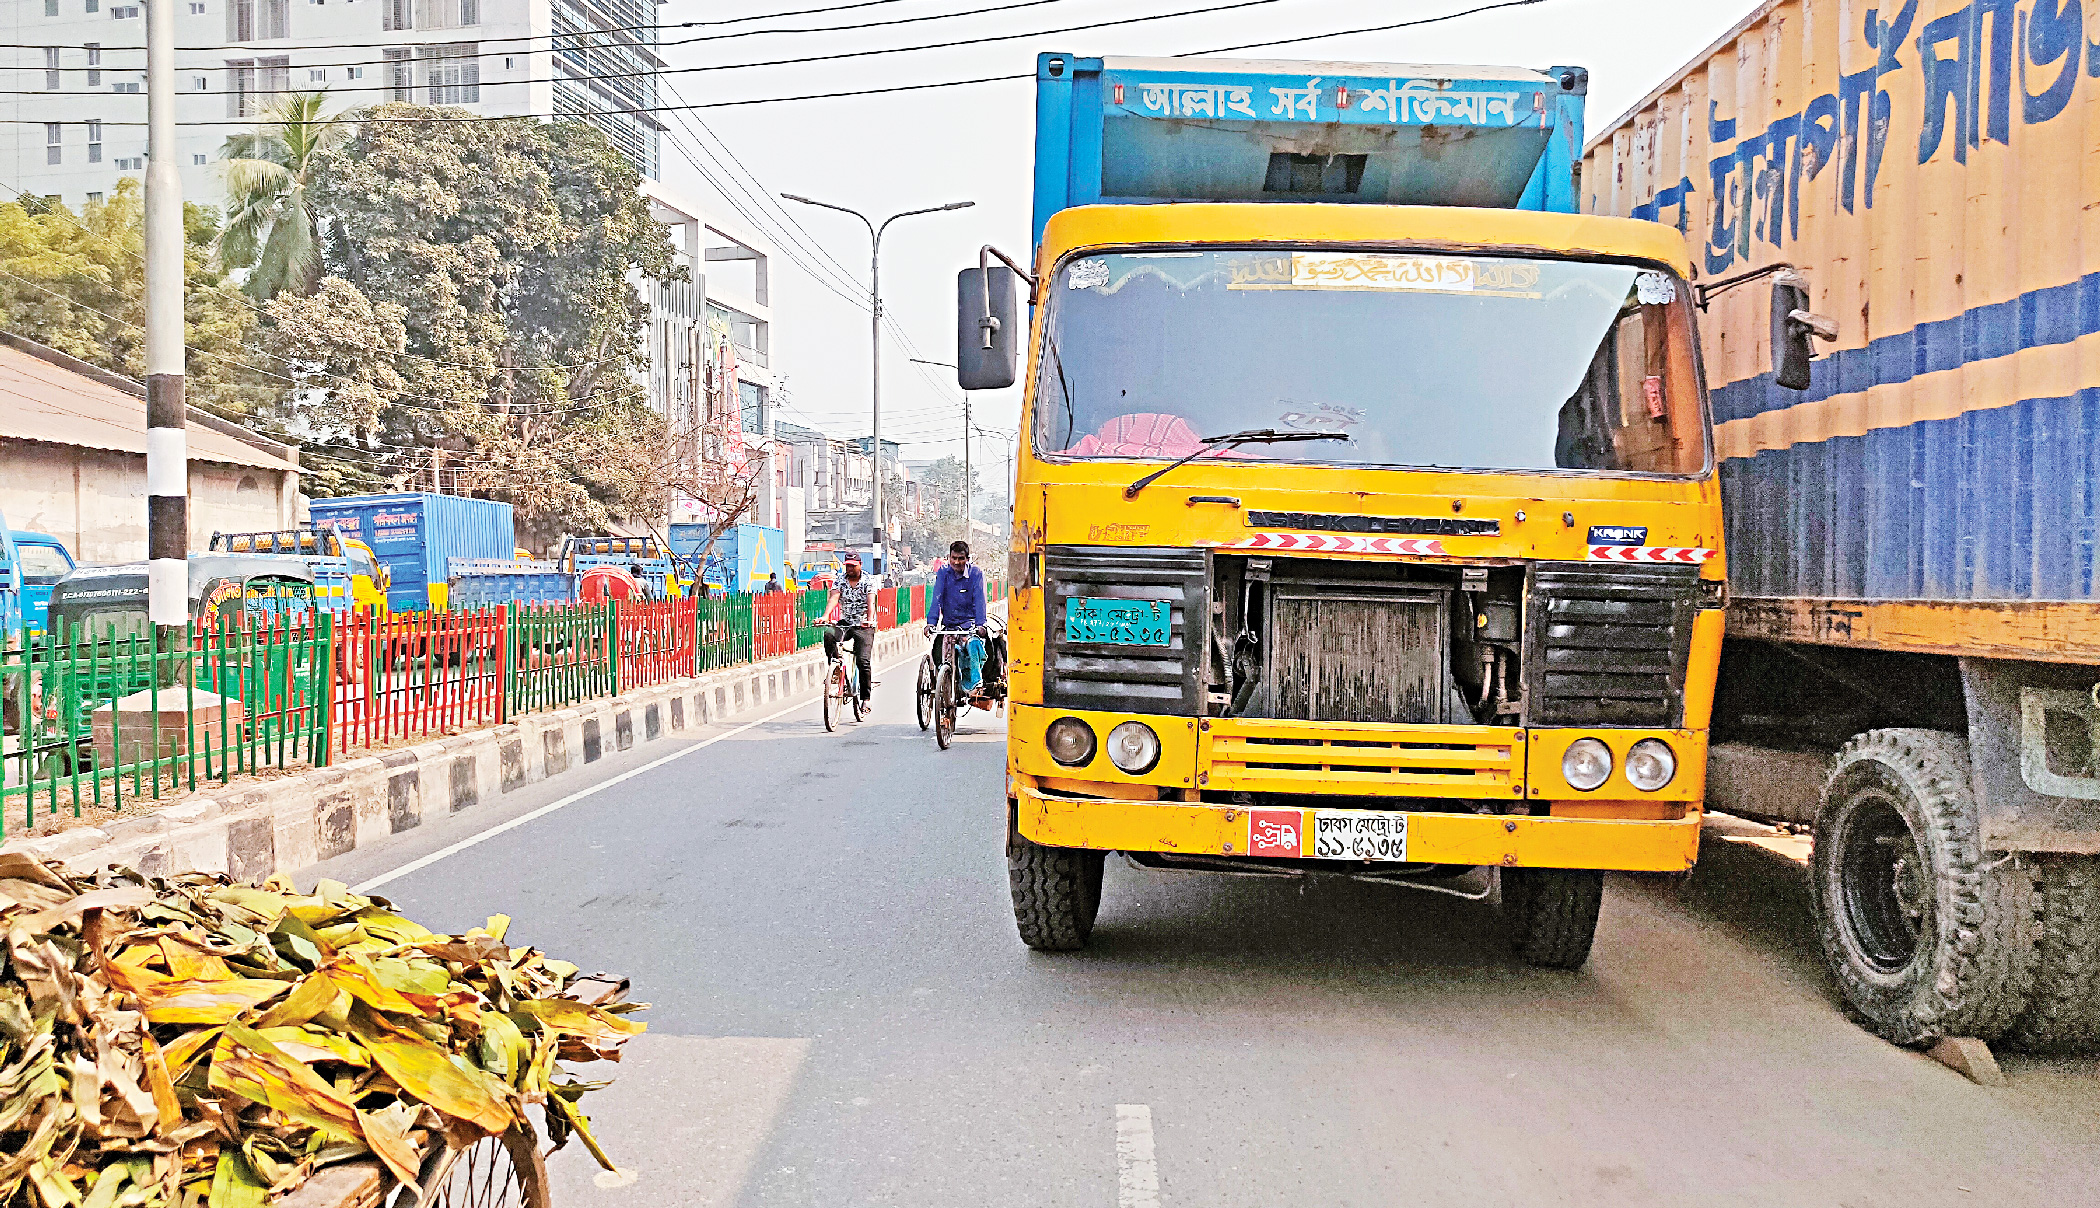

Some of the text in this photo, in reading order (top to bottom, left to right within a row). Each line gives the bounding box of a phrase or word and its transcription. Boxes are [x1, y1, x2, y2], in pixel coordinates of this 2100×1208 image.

[1138, 76, 1520, 125] আল্লাহ সর্ব শক্তিমান
[1368, 515, 1500, 535] LEYLAN
[1316, 817, 1354, 834] ঢাকা
[1317, 836, 1403, 859] ১১-৫১৩৫
